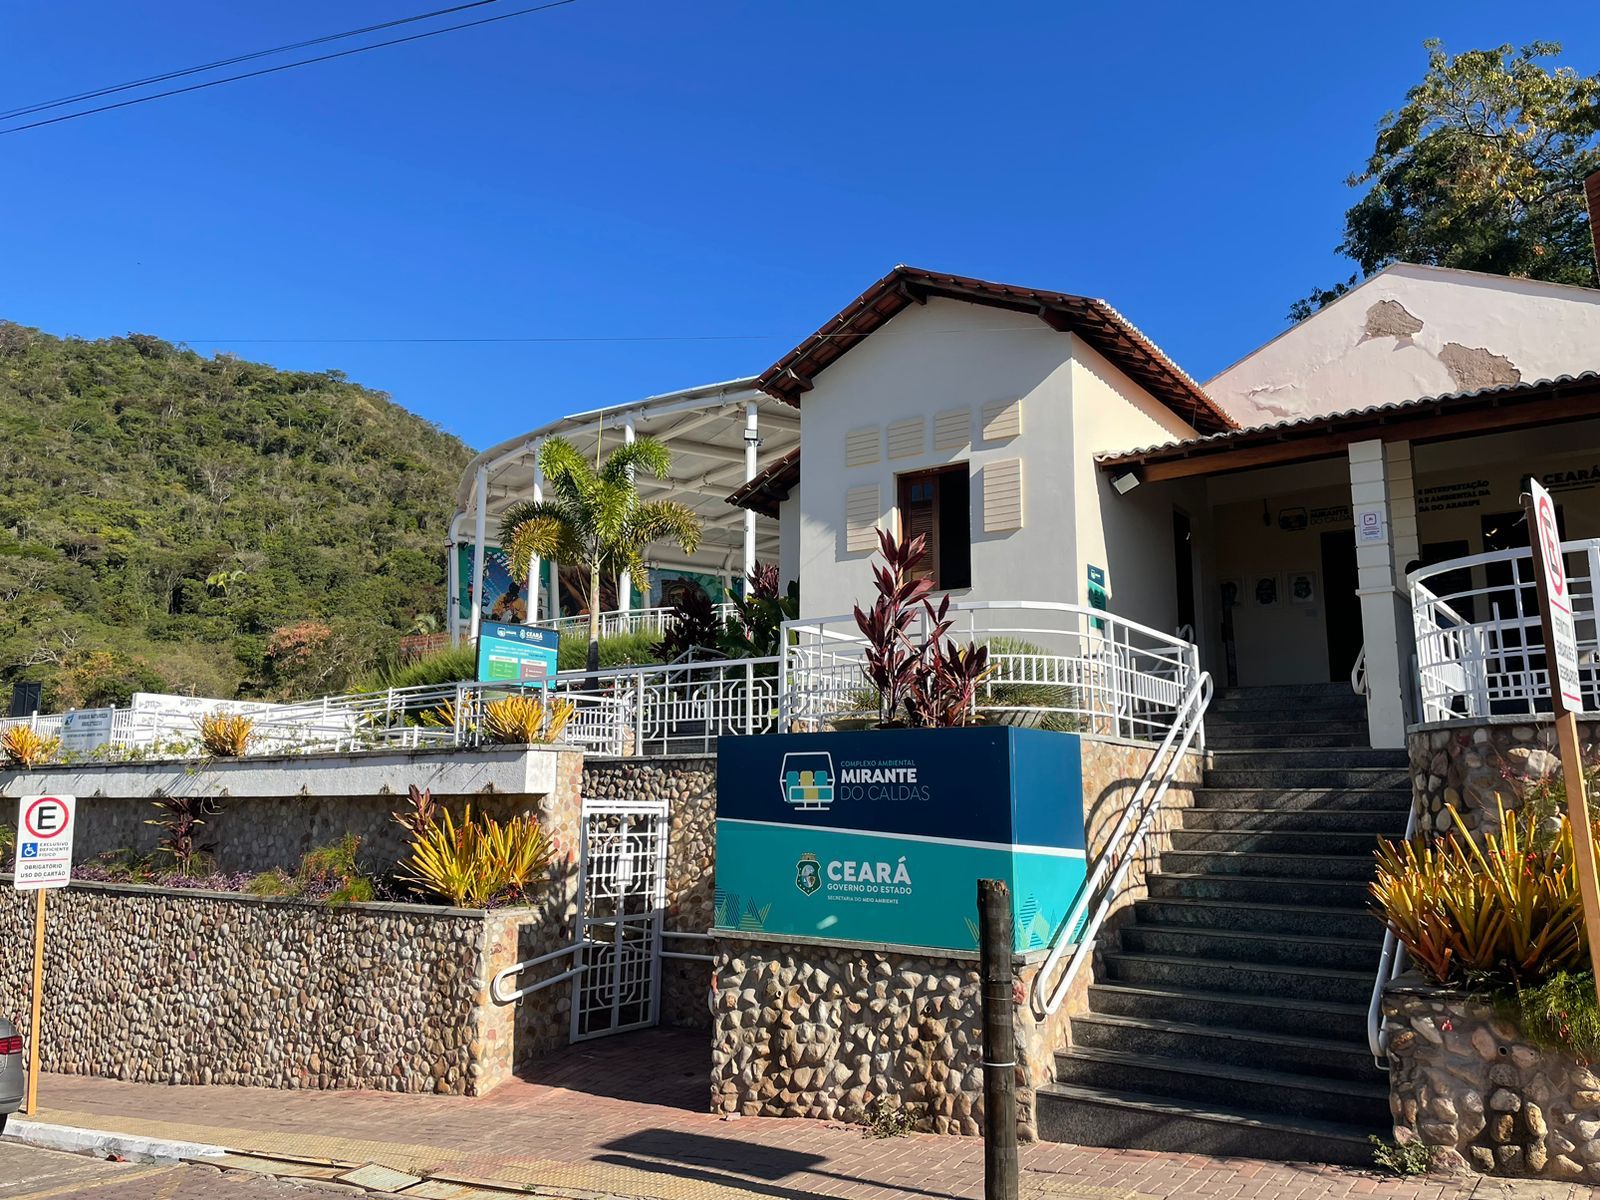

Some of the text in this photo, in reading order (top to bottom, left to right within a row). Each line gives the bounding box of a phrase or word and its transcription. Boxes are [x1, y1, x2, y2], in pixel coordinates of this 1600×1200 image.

[878, 759, 916, 767] AMBIENTAL
[841, 768, 917, 783] MIRANTE
[840, 785, 930, 801] DO CALDAS
[37, 806, 57, 830] E
[43, 869, 66, 877] CARTÃO
[827, 855, 912, 885] CEARÁ
[827, 883, 912, 895] GOVERNO DO ESTADO
